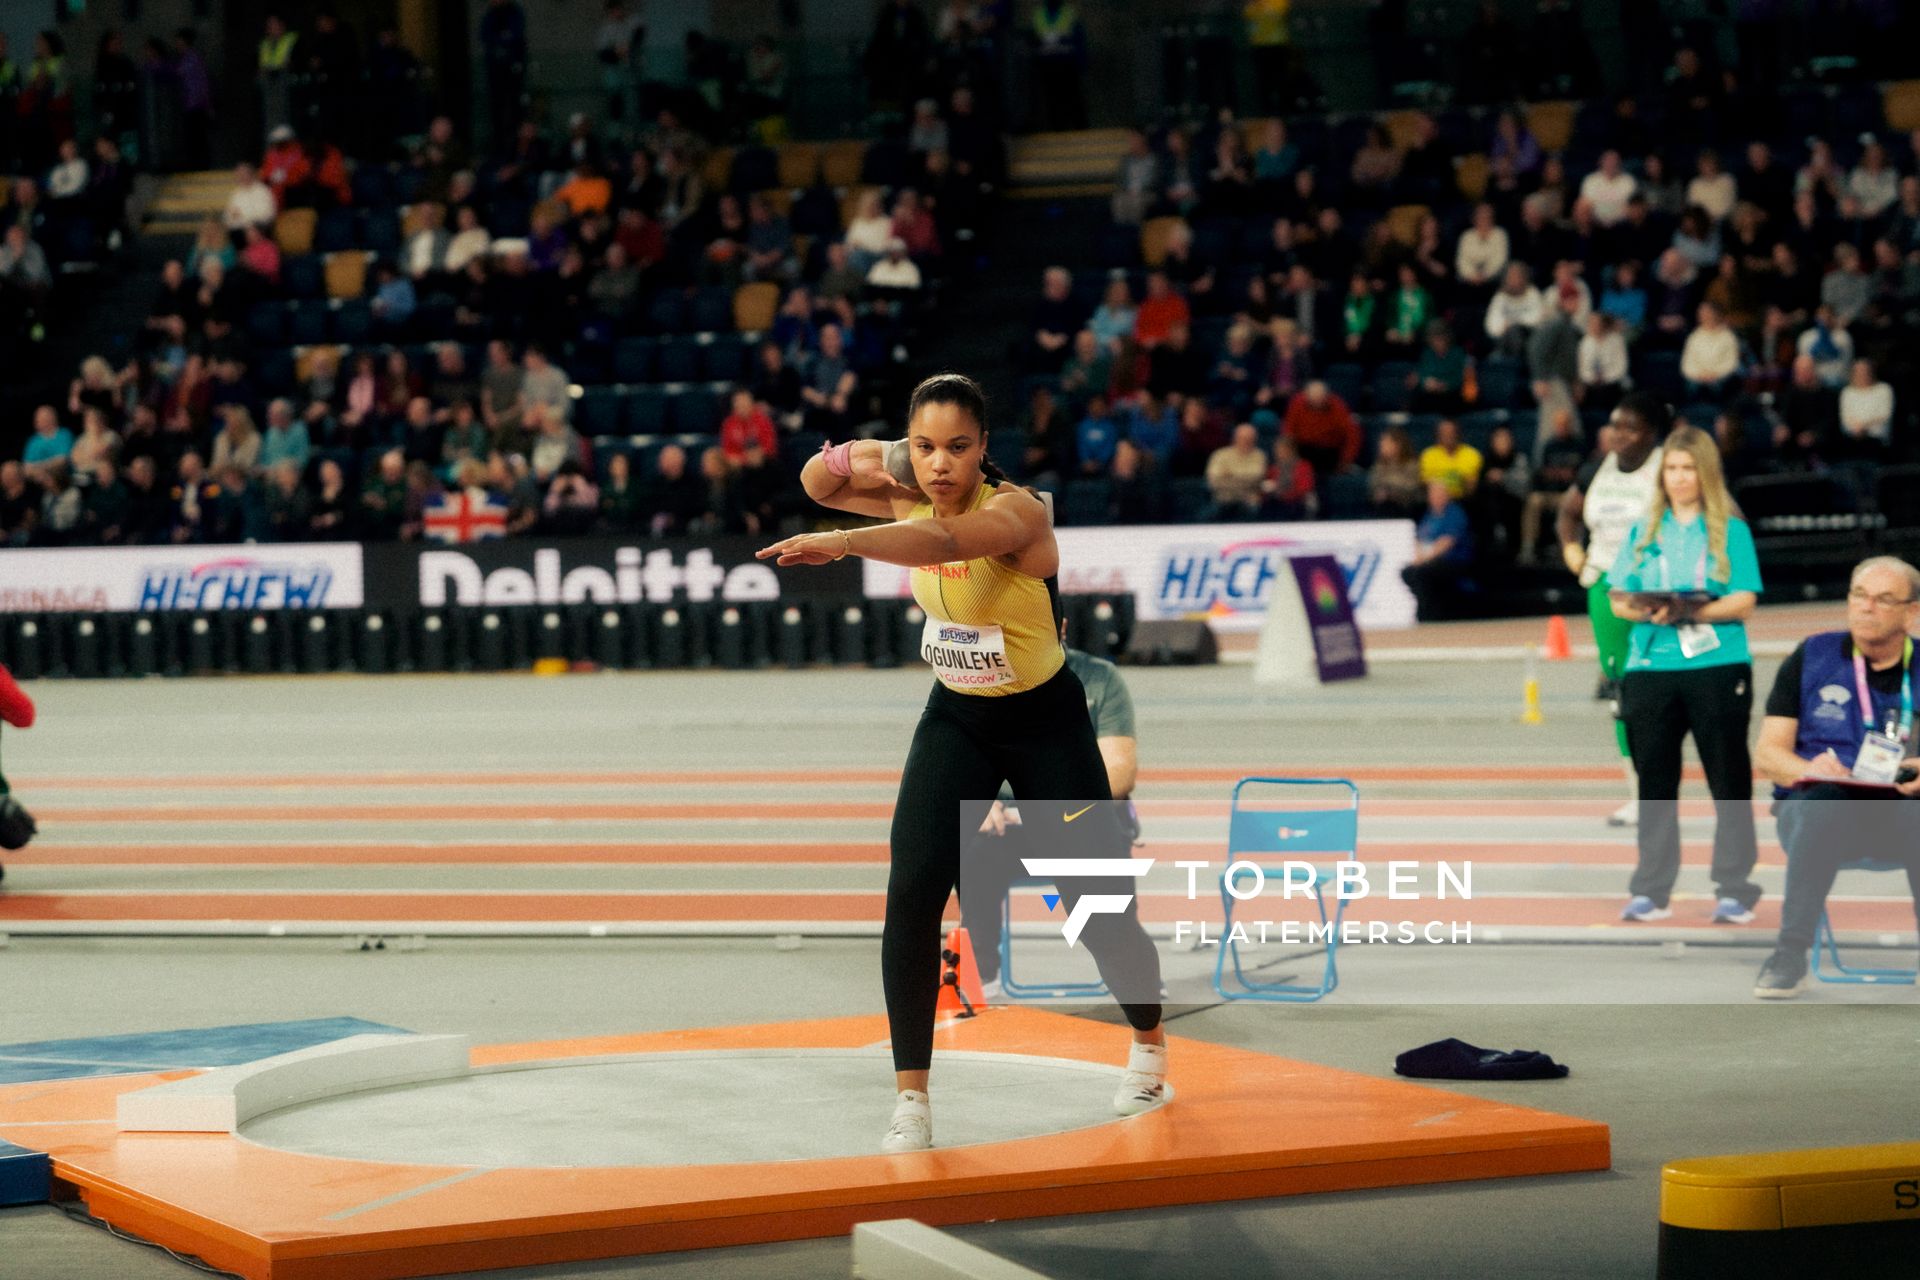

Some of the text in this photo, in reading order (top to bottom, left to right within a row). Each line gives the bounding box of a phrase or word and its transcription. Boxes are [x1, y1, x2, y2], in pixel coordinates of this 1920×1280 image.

[138, 570, 333, 611] HI-CHEW
[418, 546, 780, 605] Deloitte
[925, 644, 1005, 670] OGUNLEYE
[1894, 1180, 1920, 1210] S
